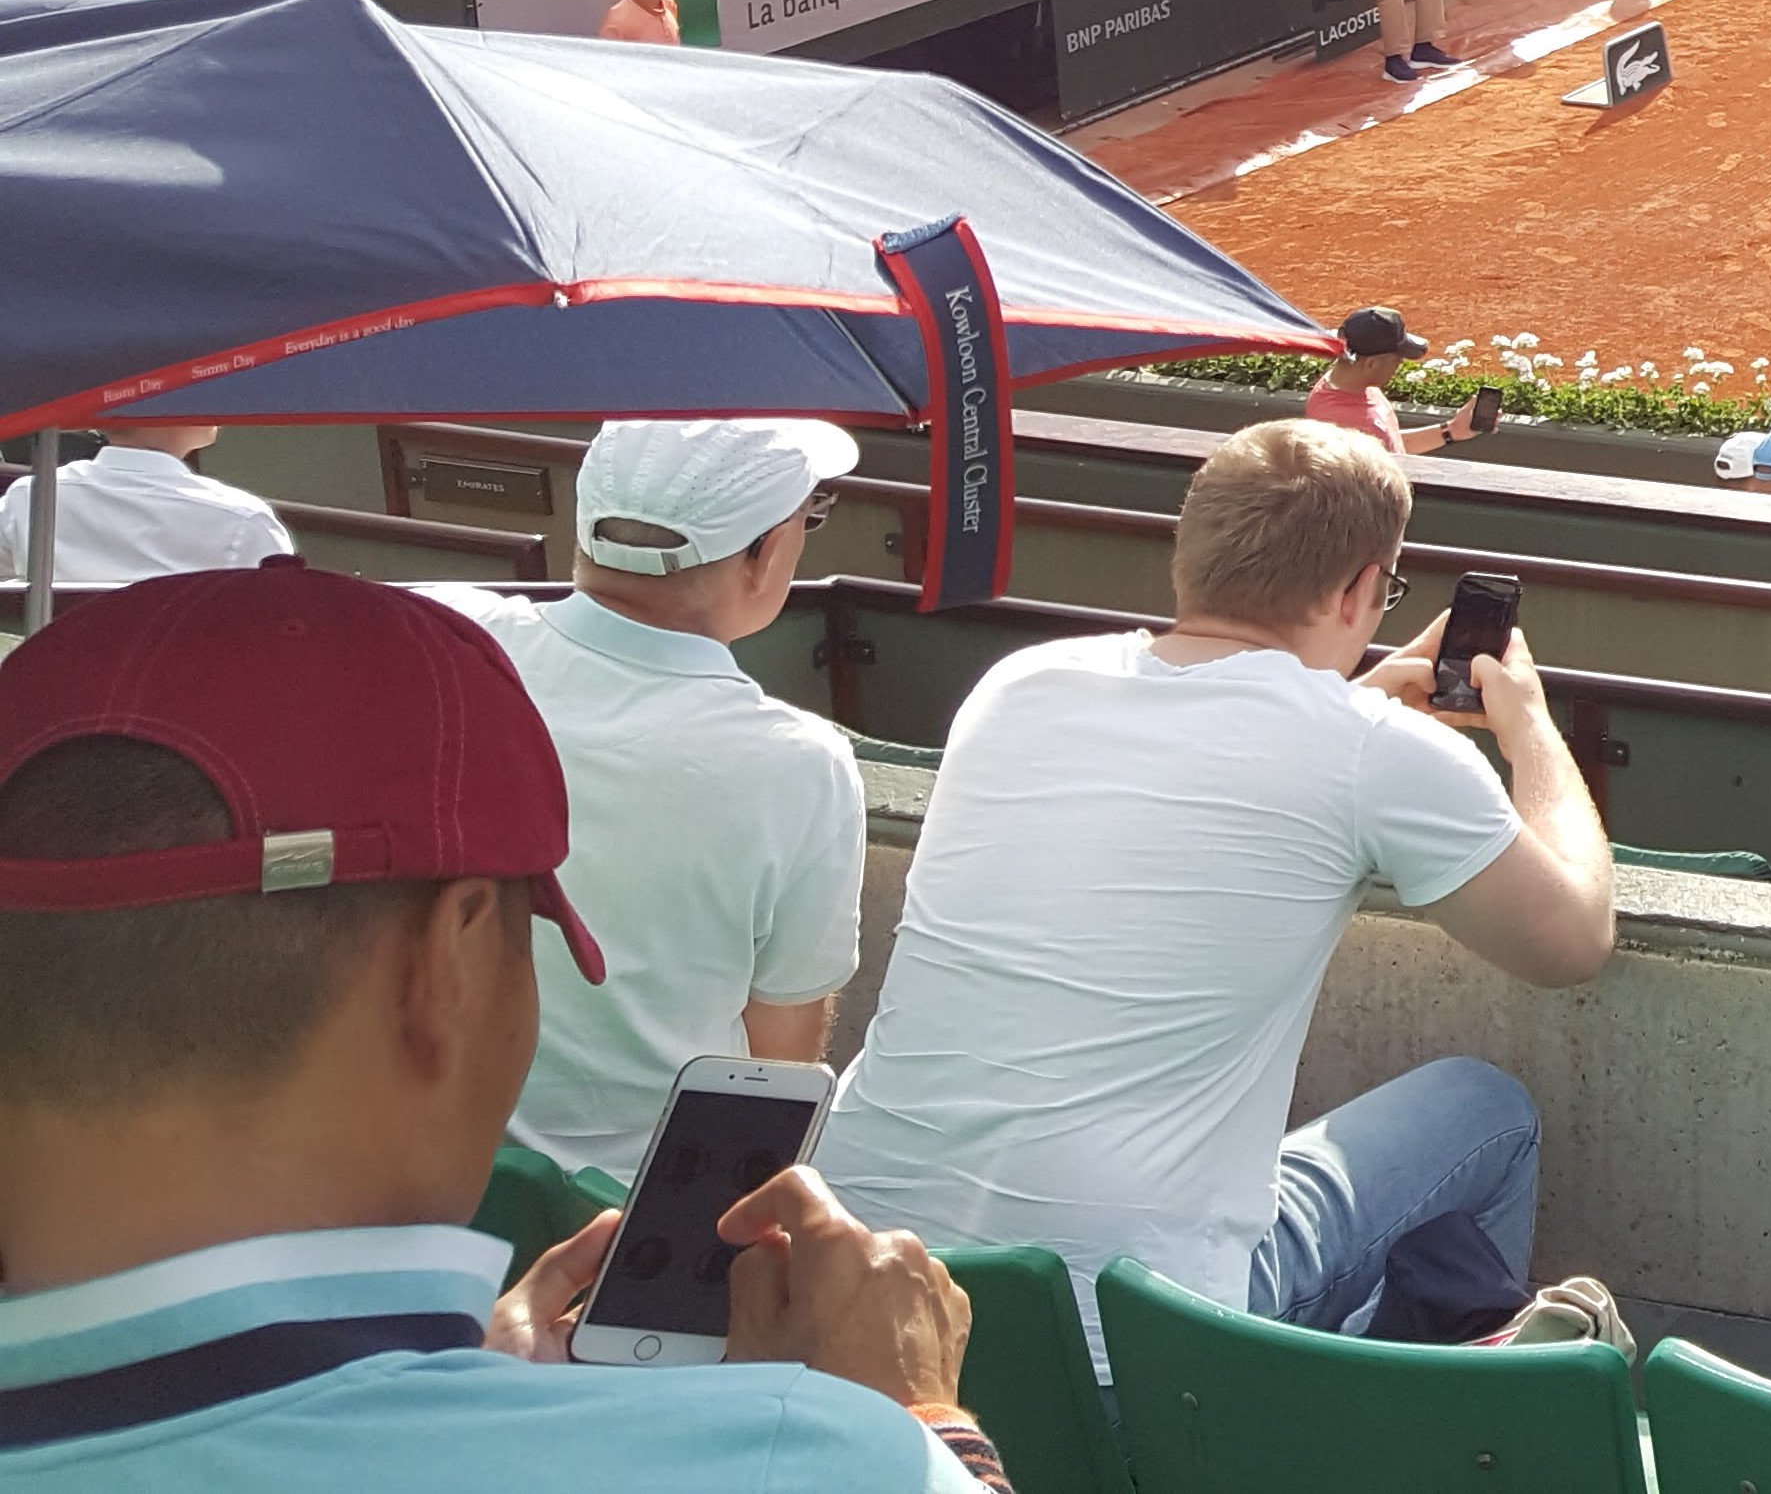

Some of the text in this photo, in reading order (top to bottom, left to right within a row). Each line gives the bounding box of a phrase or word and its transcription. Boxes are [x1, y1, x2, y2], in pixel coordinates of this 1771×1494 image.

[1065, 24, 1104, 55] BNP
[1319, 6, 1381, 47] LACOSTE
[284, 331, 337, 356] Everyday
[338, 328, 350, 343] is
[191, 354, 256, 381] Sunny Day
[139, 376, 164, 393] Day
[945, 284, 989, 535] Kowloon Central Cluster
[456, 477, 506, 495] EMIRATES
